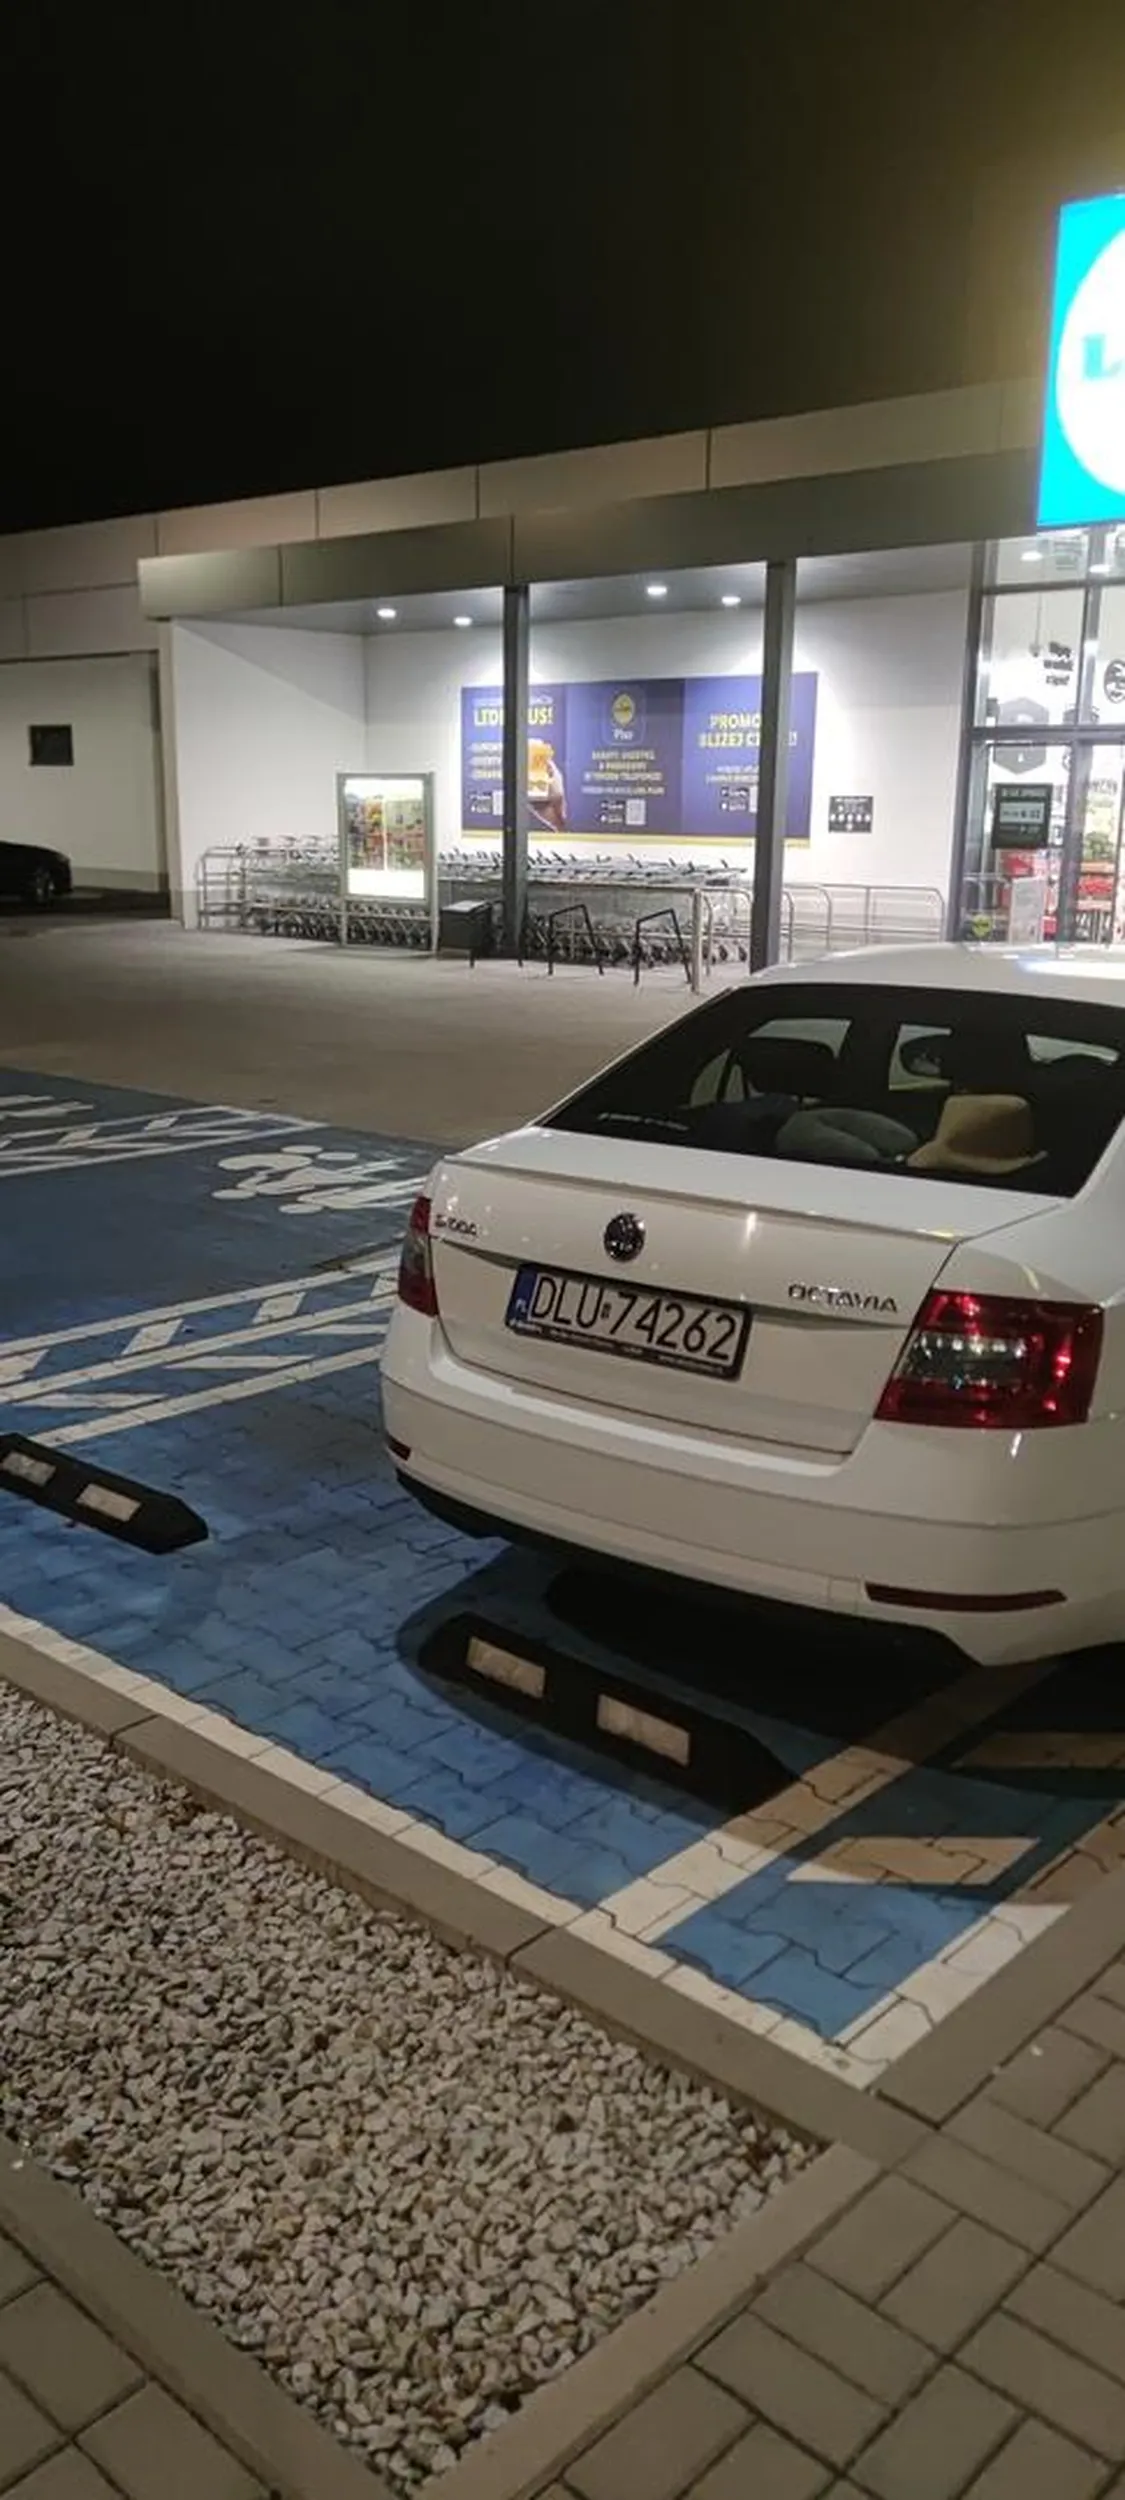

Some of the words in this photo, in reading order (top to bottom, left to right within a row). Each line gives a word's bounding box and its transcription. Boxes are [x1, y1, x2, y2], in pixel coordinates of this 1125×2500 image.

[530, 1276, 604, 1329] DLU
[608, 1290, 738, 1361] 74262
[787, 1283, 898, 1313] OCTAVIA
